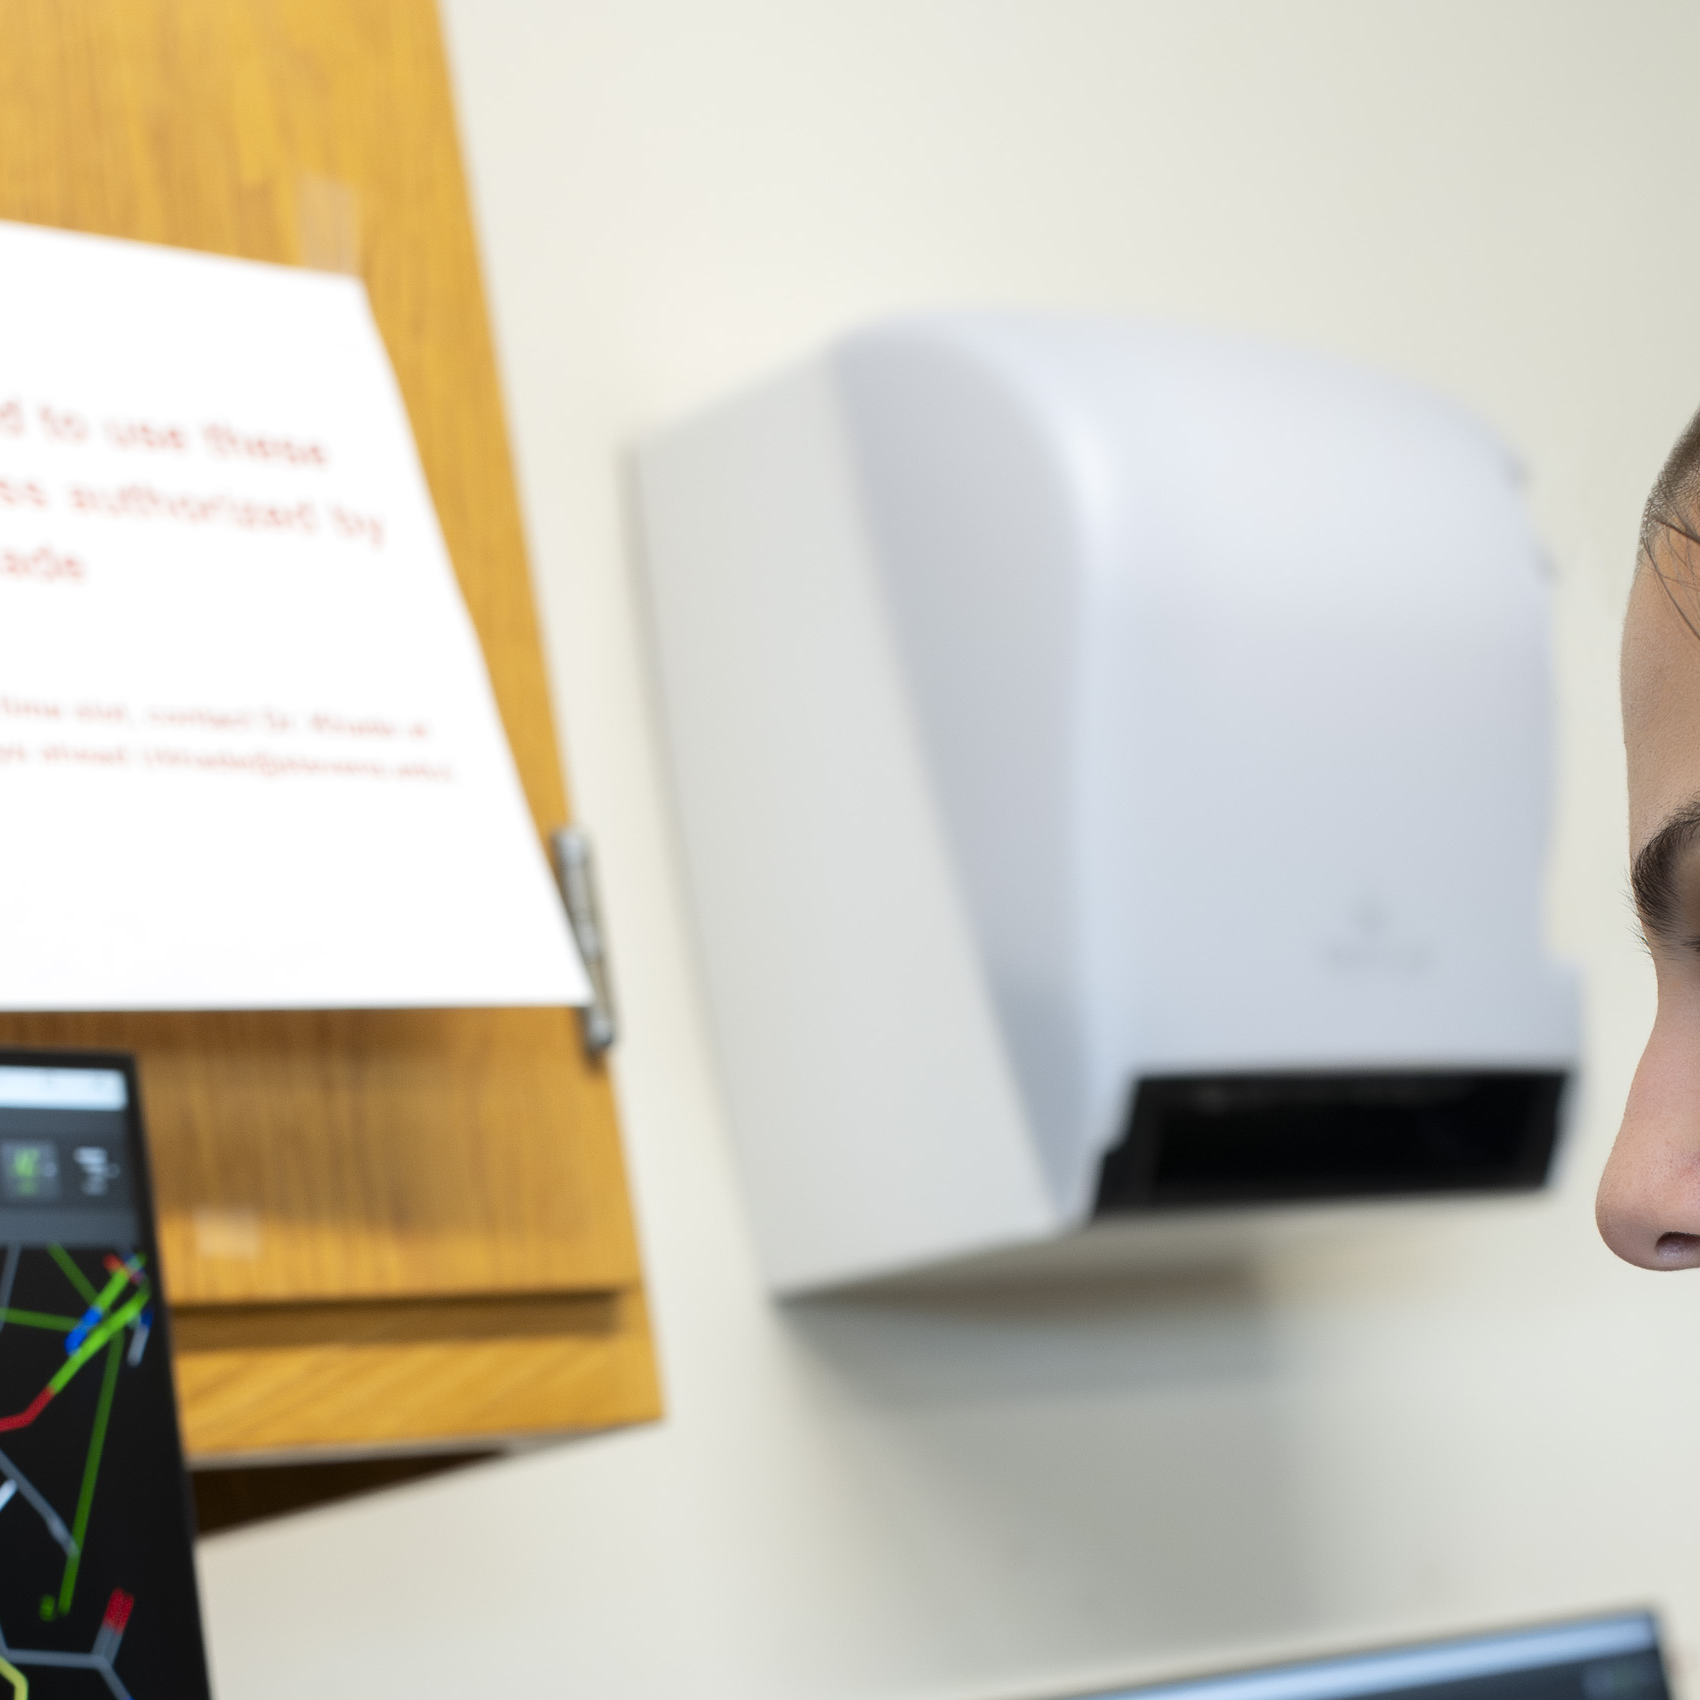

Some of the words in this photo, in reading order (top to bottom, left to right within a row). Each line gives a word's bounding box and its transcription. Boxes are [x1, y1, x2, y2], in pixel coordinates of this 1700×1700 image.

[39, 402, 89, 444] to
[104, 419, 188, 452] use
[330, 503, 385, 550] by
